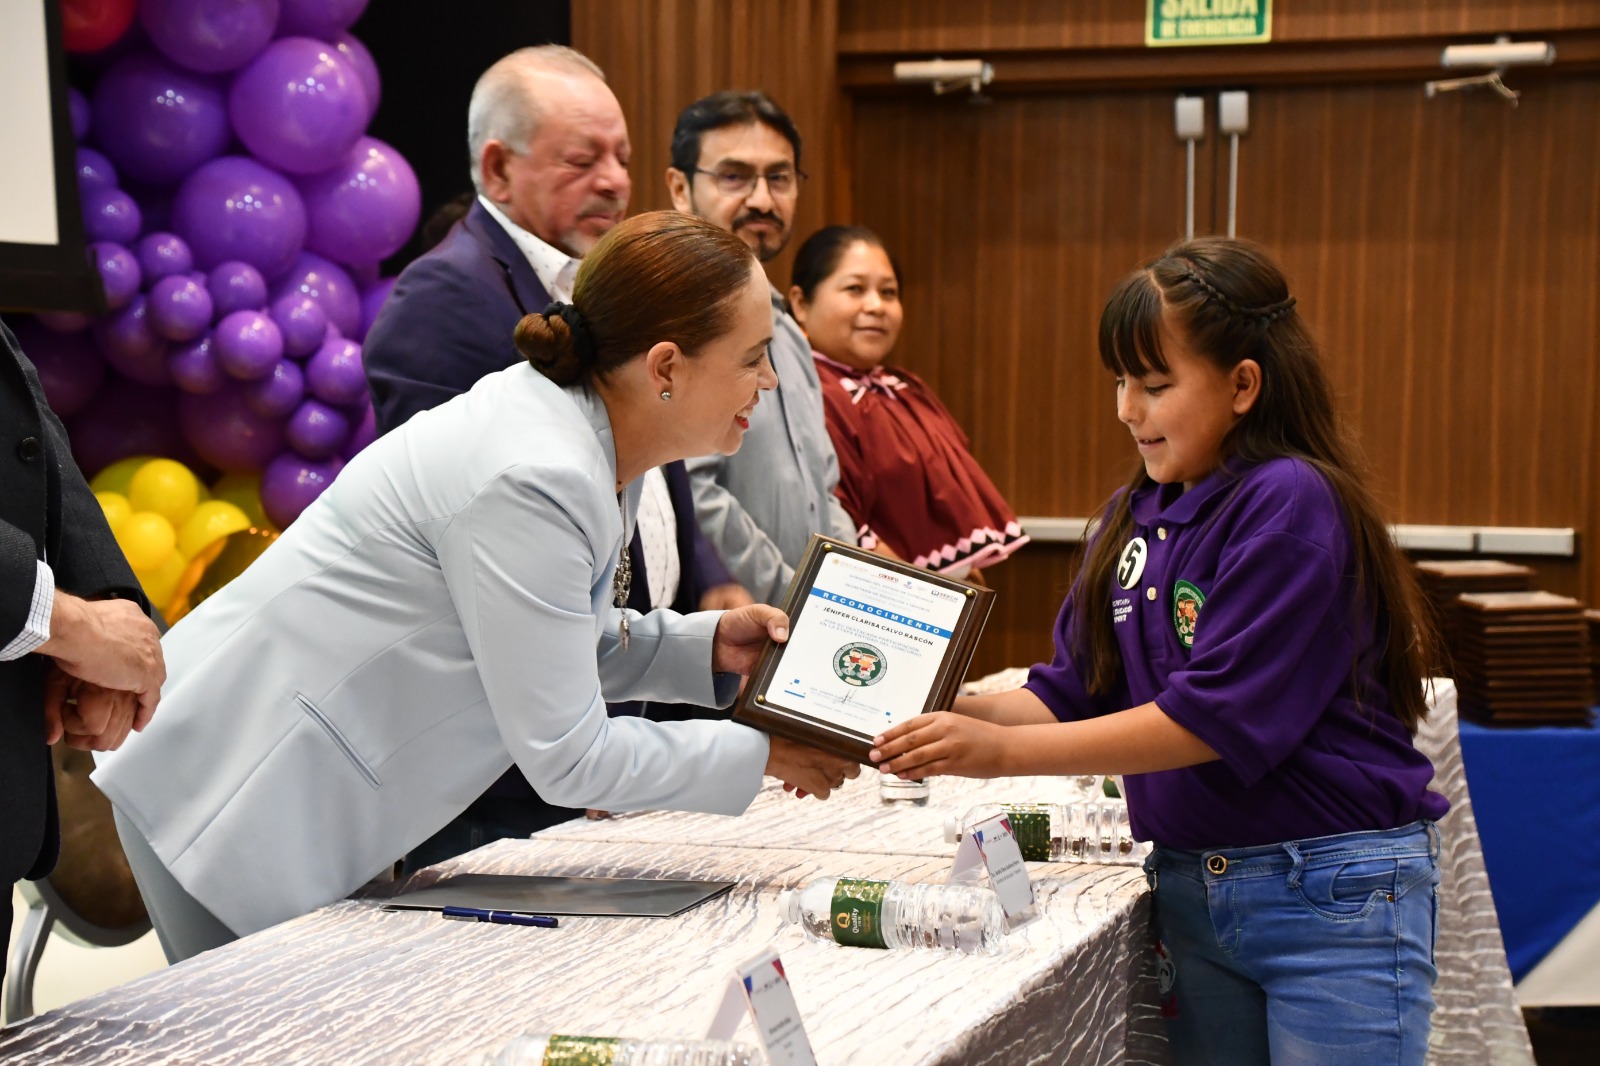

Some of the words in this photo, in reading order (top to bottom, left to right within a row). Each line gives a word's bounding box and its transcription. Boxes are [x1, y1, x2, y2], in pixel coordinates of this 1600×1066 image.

[1118, 540, 1142, 588] 5
[823, 592, 940, 634] RECONOCIMIENTO
[851, 615, 880, 629] CLARISA
[881, 625, 904, 636] CALVO
[904, 632, 934, 646] RASCÓN
[851, 907, 860, 934] Quality
